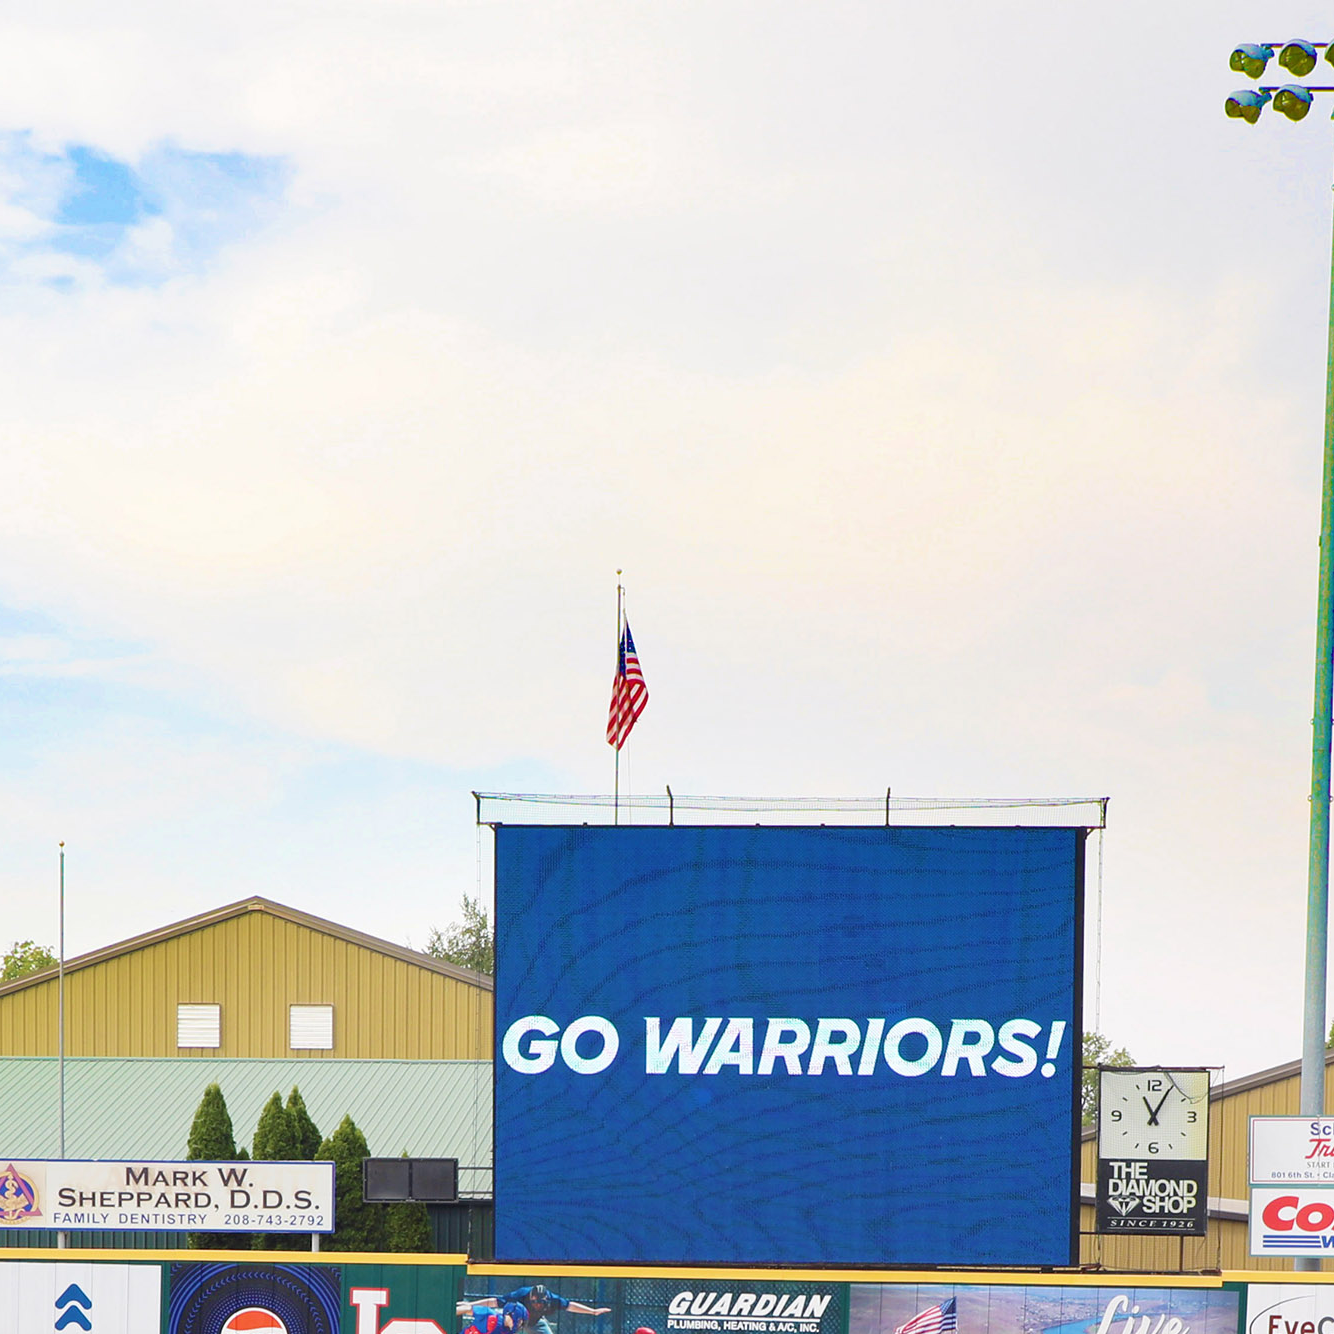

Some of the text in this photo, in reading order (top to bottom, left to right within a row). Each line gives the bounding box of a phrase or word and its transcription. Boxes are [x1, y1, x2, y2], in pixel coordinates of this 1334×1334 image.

[502, 1015, 1066, 1078] GO WARRIORS!
[1148, 1080, 1162, 1091] 12
[1112, 1110, 1197, 1123] 9 3
[1148, 1142, 1159, 1154] 6
[125, 1167, 254, 1188] MARK W.
[1109, 1162, 1148, 1179] THE
[1108, 1179, 1198, 1197] DIAMOND
[58, 1188, 320, 1213] SHEPPARD, D.D.S.
[1142, 1196, 1197, 1213] SHOP
[53, 1212, 325, 1226] FAMILY DENTISTRY 208-743-2792
[1161, 1220, 1194, 1228] 1926
[667, 1291, 831, 1318] GUARDIAN
[667, 1319, 820, 1333] PLUMBING, HEATING & A/C, INC.
